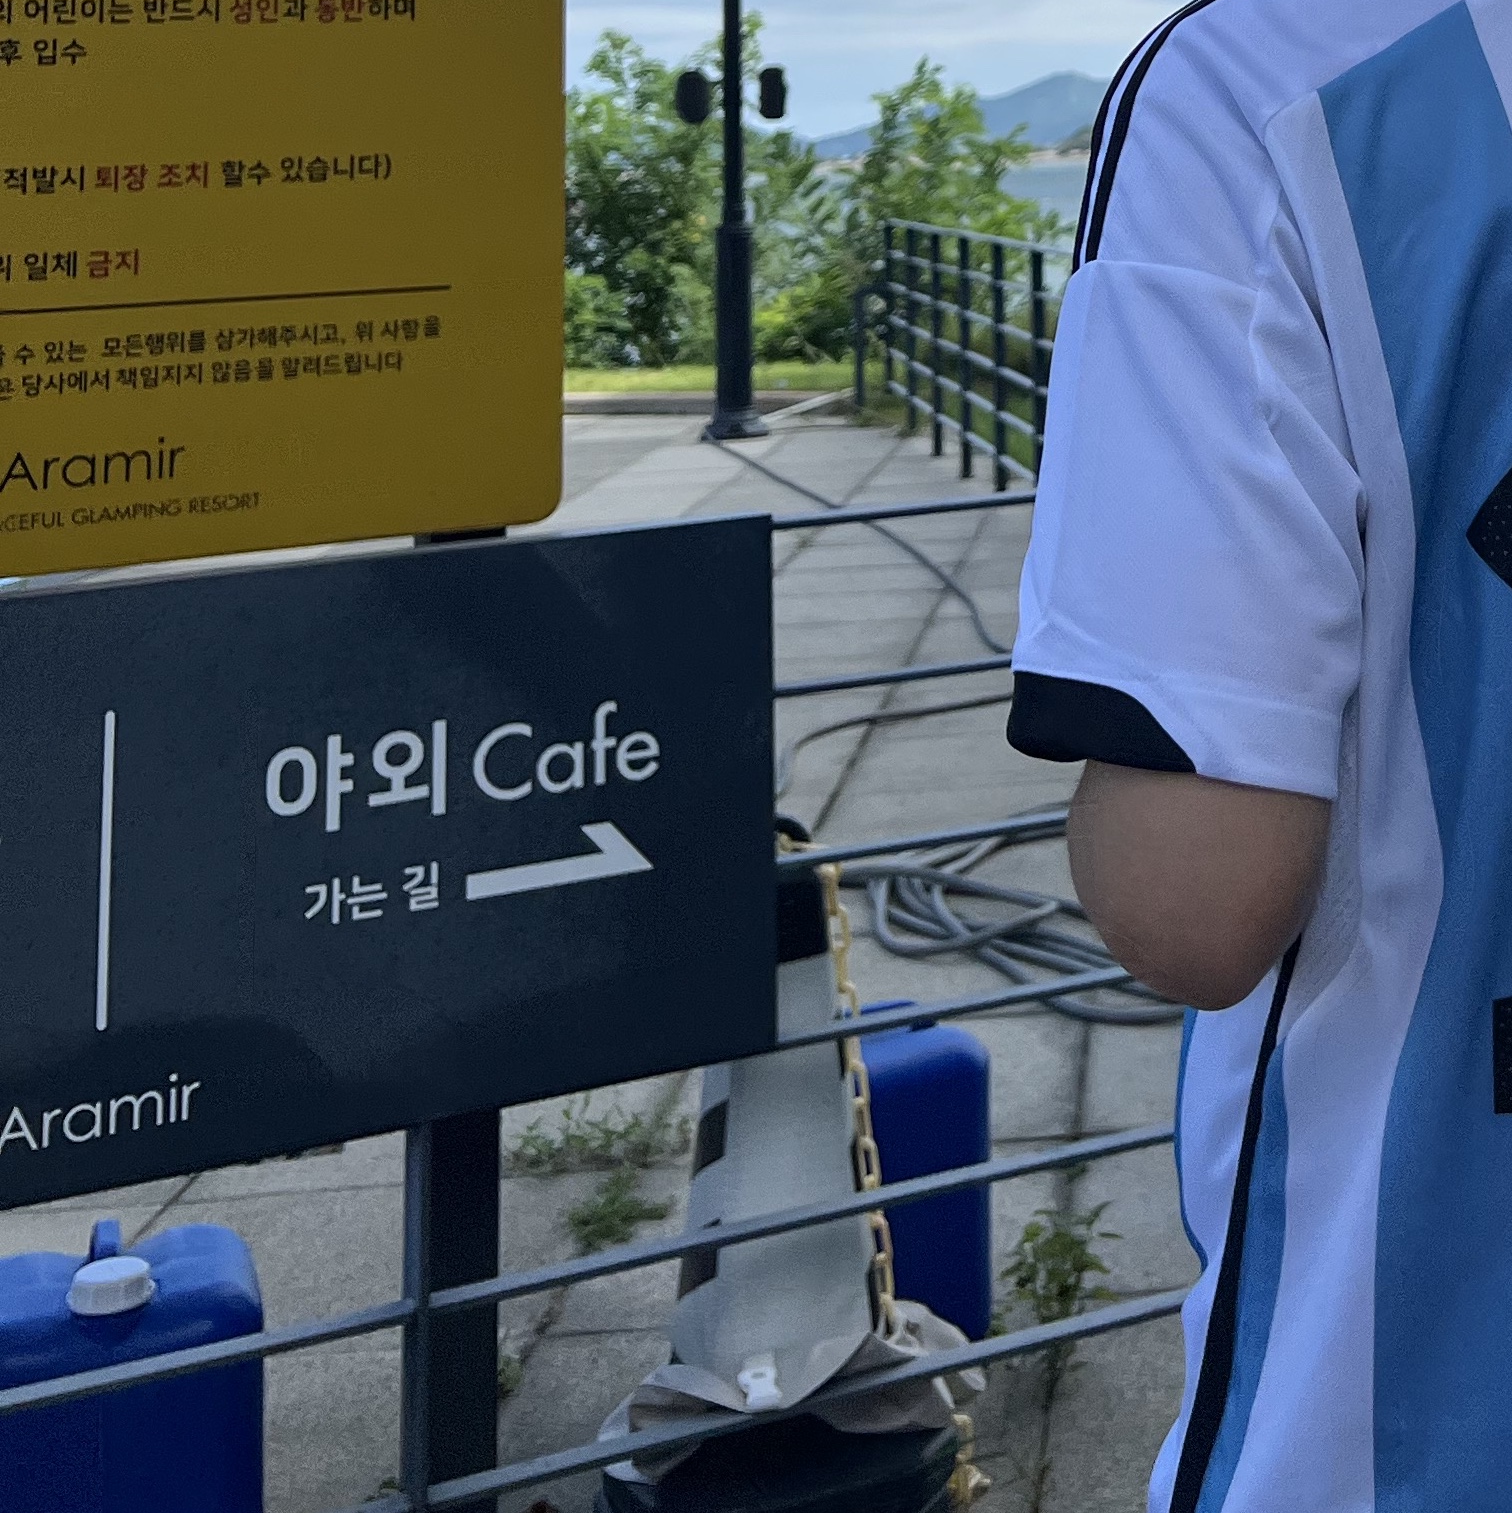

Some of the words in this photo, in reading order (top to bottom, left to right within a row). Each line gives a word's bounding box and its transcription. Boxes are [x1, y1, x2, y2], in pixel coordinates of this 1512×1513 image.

[34, 38, 88, 66] 입수
[4, 164, 85, 195] 적발시
[95, 163, 148, 193] 퇴장
[157, 161, 210, 190] 조치
[280, 153, 392, 185] 있습니다)
[24, 251, 78, 282] 일체
[88, 248, 140, 279] 금지
[15, 344, 36, 365] 수
[45, 340, 87, 365] 있는
[22, 368, 110, 397] 당사에서
[0, 436, 185, 493] Aramir
[71, 498, 181, 525] GLAMPING
[189, 491, 260, 515] RESORT
[265, 717, 448, 832] 야외
[472, 700, 661, 803] Cafe
[303, 874, 389, 926] 가는
[402, 861, 442, 913] 길
[0, 1074, 200, 1156] Aramir
